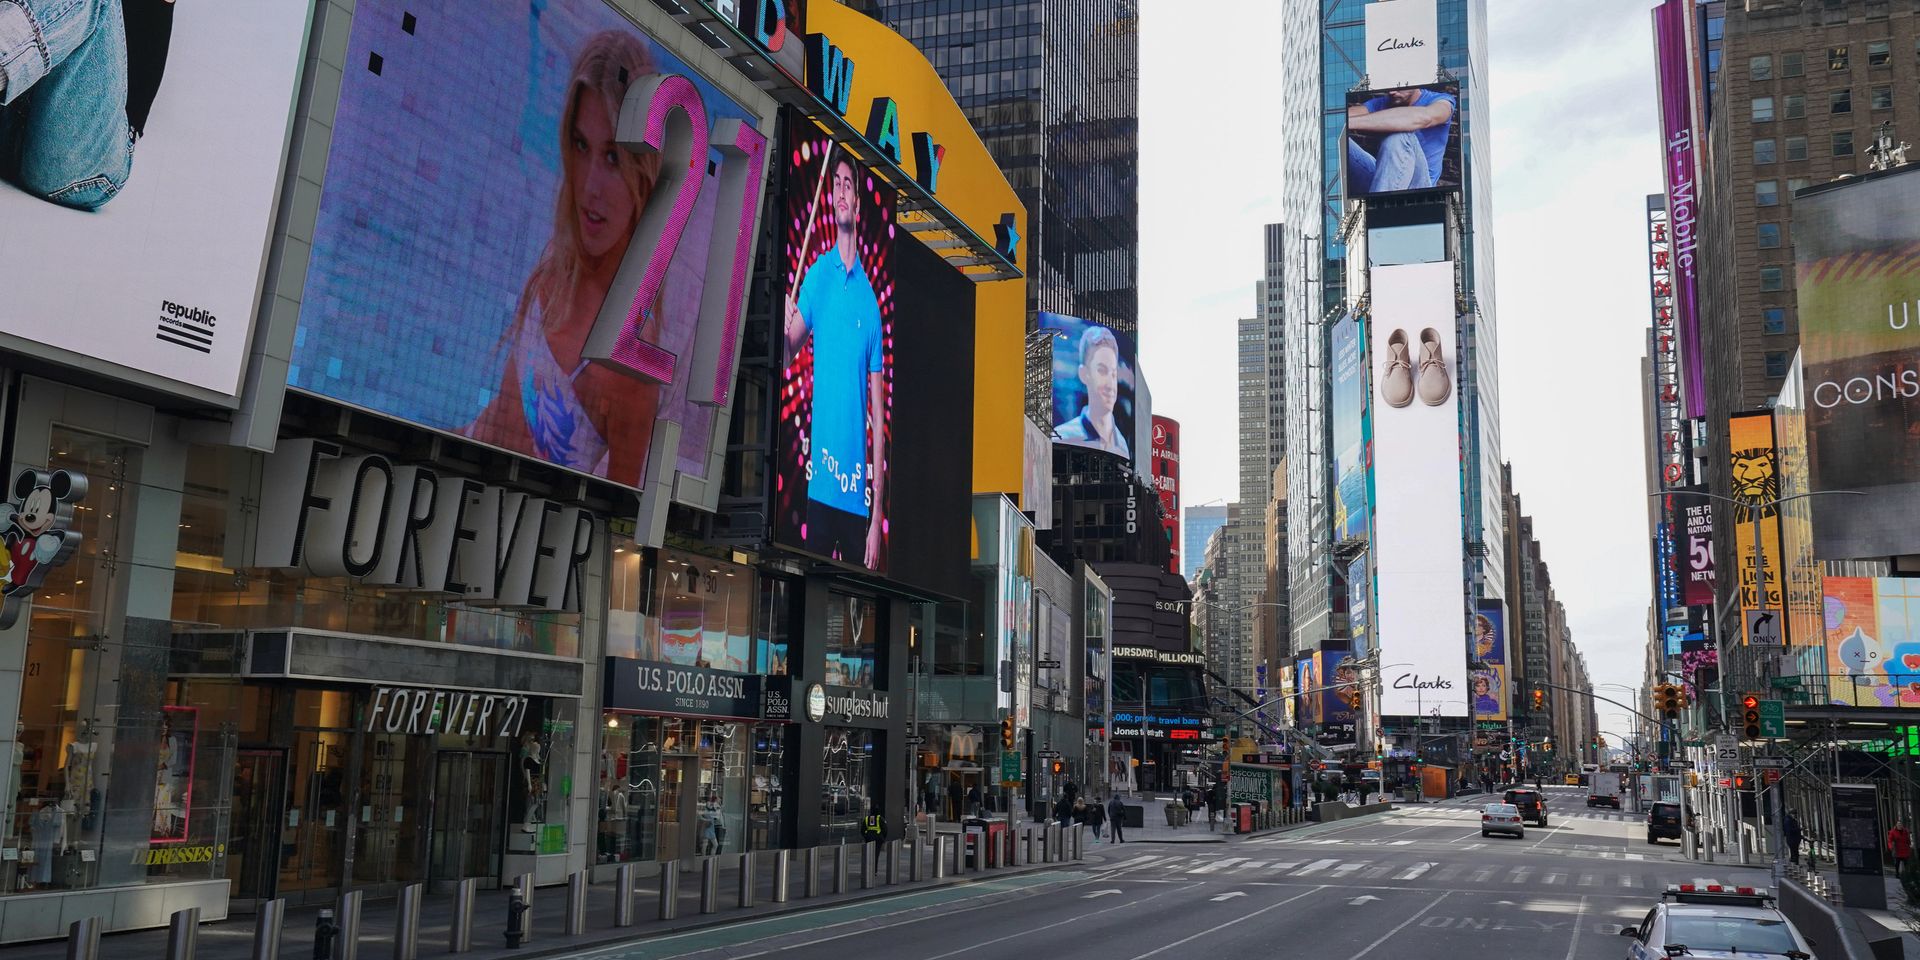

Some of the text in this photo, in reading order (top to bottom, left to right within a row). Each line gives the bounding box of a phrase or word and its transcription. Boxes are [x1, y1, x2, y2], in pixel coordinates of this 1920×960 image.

[1377, 37, 1425, 52] Clarks
[717, 0, 946, 194] DWAY
[586, 72, 769, 405] 21
[1653, 223, 1672, 354] ERNST
[161, 299, 217, 328] republic
[1889, 299, 1920, 330] U
[159, 315, 183, 328] records
[1660, 386, 1677, 403] &
[1814, 369, 1920, 408] CONS
[1126, 484, 1137, 534] 1500
[1686, 507, 1703, 517] THE
[288, 438, 599, 613] FOREVER
[1687, 516, 1704, 527] AND
[703, 572, 717, 594] $30
[1691, 570, 1715, 582] NETW
[1753, 635, 1777, 644] ONLY
[1159, 653, 1194, 664] MILLION
[29, 662, 41, 677] 21
[637, 666, 746, 699] U.S. POLO ASSN.
[1393, 673, 1453, 690] Clarks
[767, 690, 782, 699] U.S.
[675, 697, 694, 708] SINCE
[767, 698, 789, 706] POLO
[826, 690, 889, 723] sunglass hut
[367, 687, 529, 738] FOREVER 21
[766, 705, 790, 714] ASSN.
[1158, 716, 1180, 725] travel
[1482, 722, 1502, 730] hulu
[1114, 727, 1138, 736] Jones
[1170, 729, 1199, 739] ESPN
[1343, 724, 1355, 732] FX
[1719, 748, 1738, 759] 25
[1230, 769, 1267, 778] DISCOVER
[1230, 791, 1267, 801] SECRETS
[145, 845, 214, 866] DRESSES
